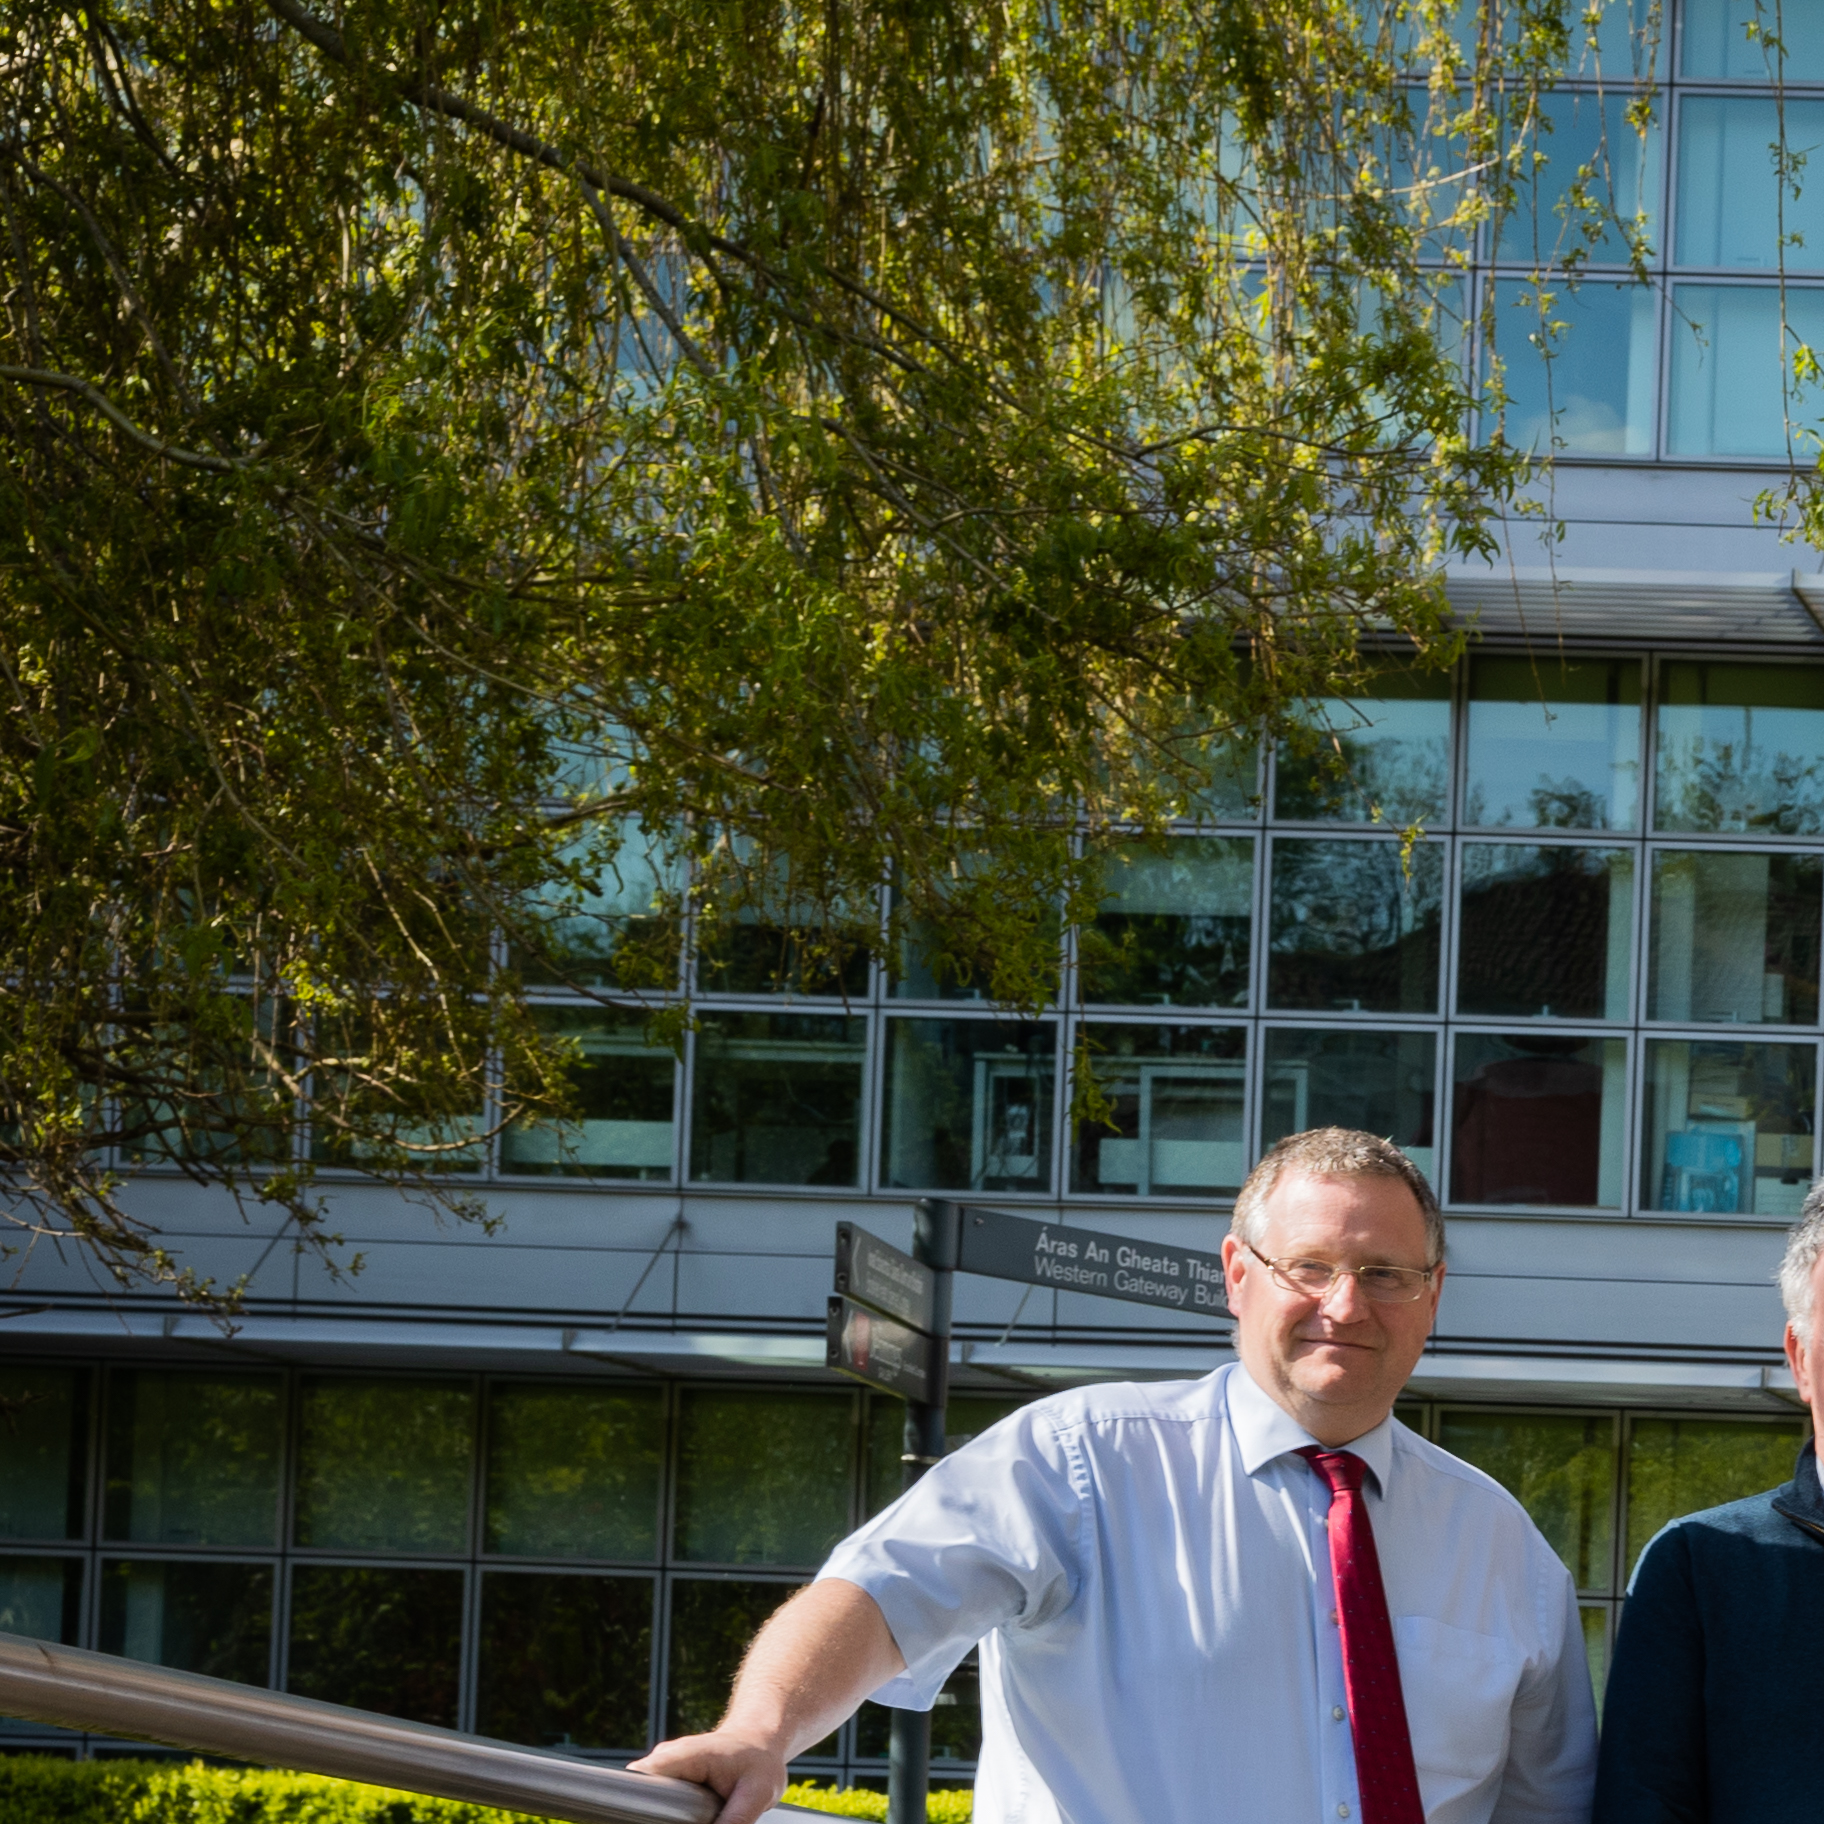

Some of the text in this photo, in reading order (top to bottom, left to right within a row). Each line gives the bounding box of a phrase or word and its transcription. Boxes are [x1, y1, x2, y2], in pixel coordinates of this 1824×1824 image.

[1036, 1226, 1078, 1258] Áras
[1084, 1241, 1110, 1264] An
[1116, 1246, 1180, 1276] Gheata
[1034, 1256, 1108, 1288] Western
[1114, 1270, 1188, 1306] Gateway
